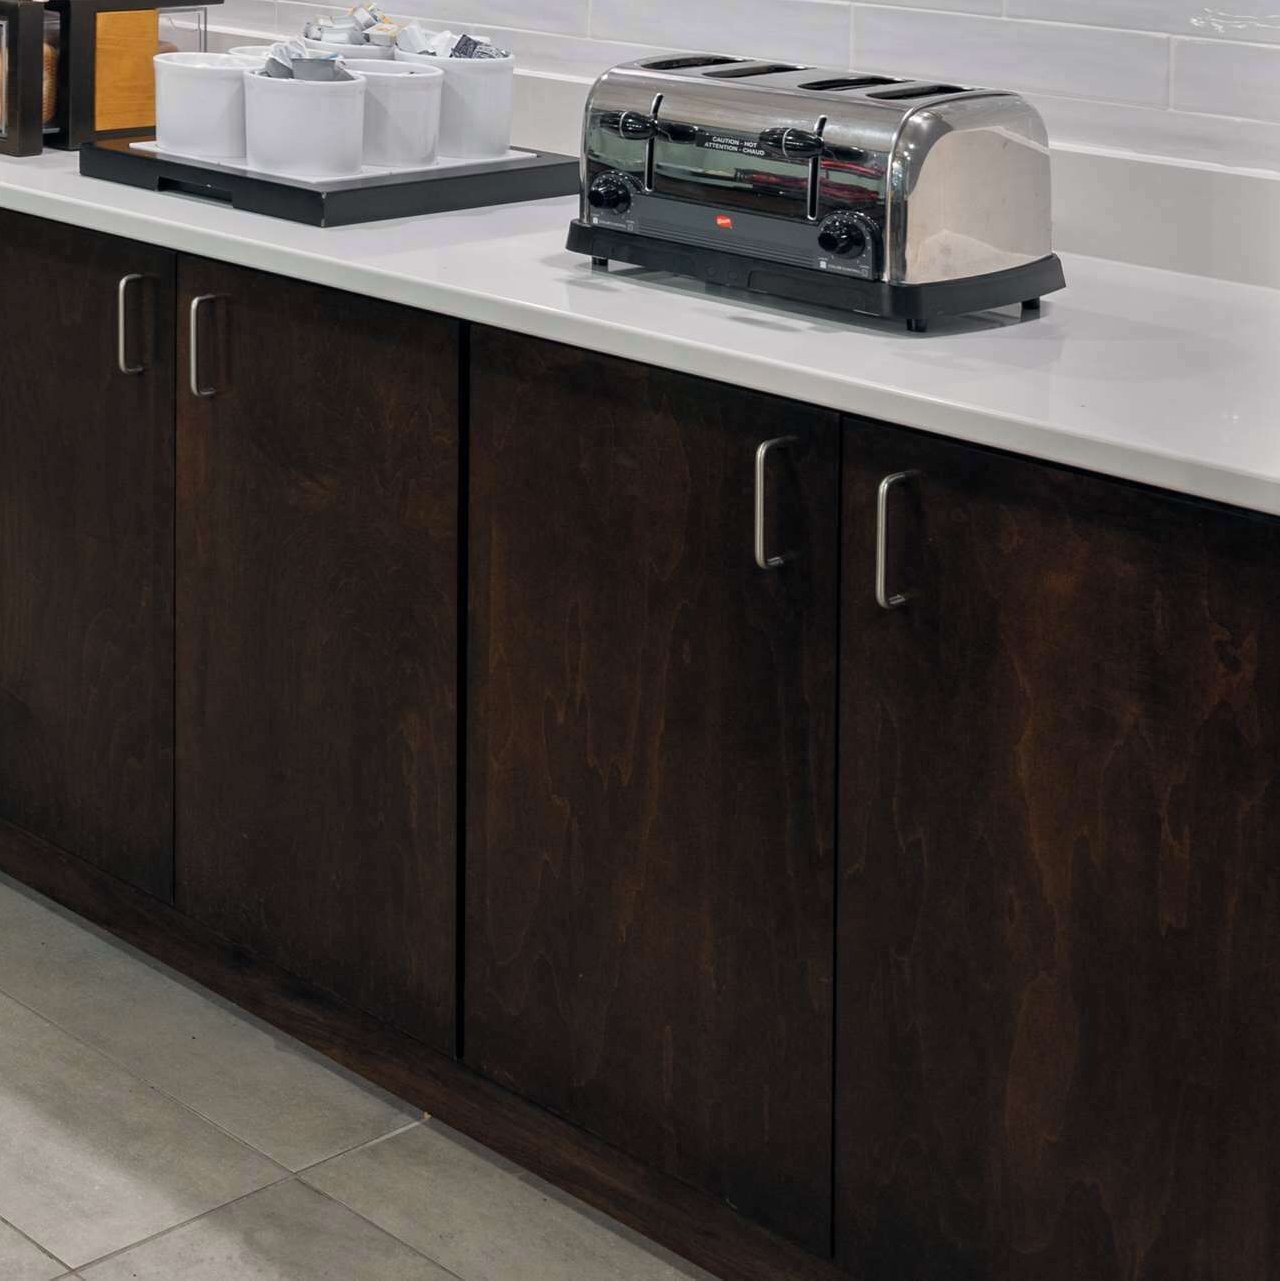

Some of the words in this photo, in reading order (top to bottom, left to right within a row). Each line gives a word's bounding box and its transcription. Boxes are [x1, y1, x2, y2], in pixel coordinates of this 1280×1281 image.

[712, 136, 739, 146] CAUTION
[704, 142, 738, 151] ATTENTION
[742, 147, 766, 156] CHAUD
